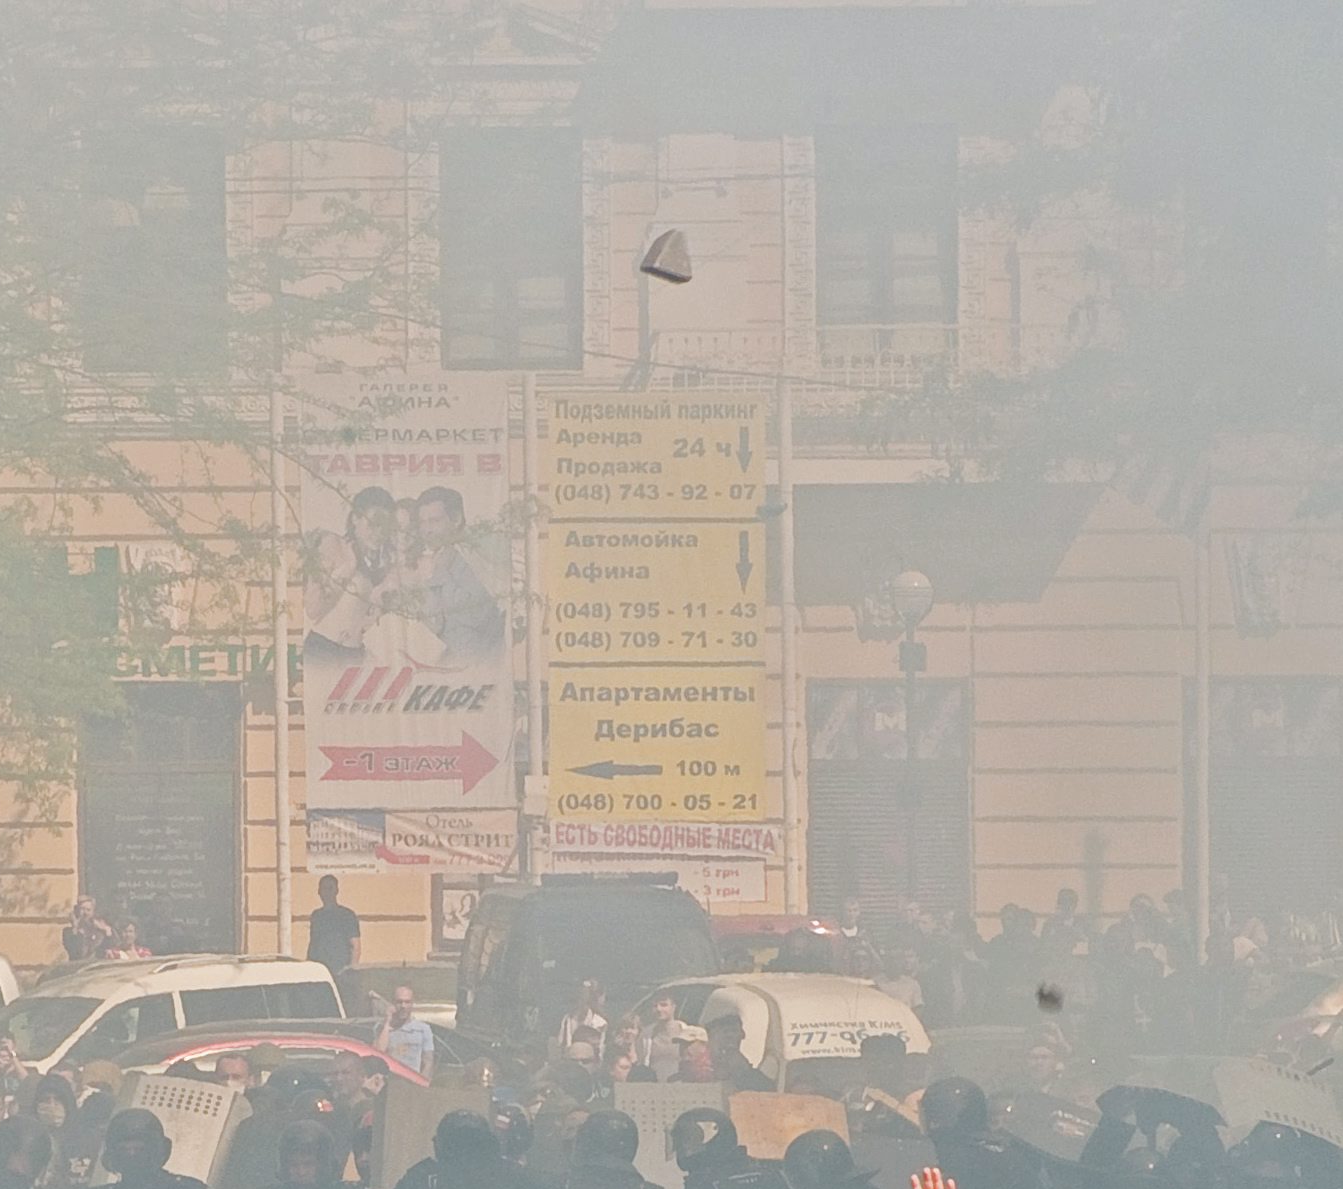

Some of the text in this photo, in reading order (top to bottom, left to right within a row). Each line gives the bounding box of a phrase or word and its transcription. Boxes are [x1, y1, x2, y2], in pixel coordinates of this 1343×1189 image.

[555, 401, 758, 422] Подземный паркинг
[556, 428, 643, 447] Аренда
[673, 437, 731, 457] 24 ч
[305, 453, 502, 475] ТАВРИЯ В
[556, 457, 662, 477] Продажа
[554, 483, 613, 505] (048)
[619, 484, 660, 501] 743
[681, 484, 708, 501] 92
[729, 484, 757, 501] 07
[565, 530, 698, 550] Автомойка
[565, 562, 650, 583] Афина
[555, 601, 613, 623] (048)
[619, 602, 660, 619] 795
[684, 602, 707, 619] 11
[730, 602, 757, 619] 43
[556, 630, 613, 652] (048)
[619, 631, 660, 649] 709
[683, 631, 707, 649] 71
[730, 631, 758, 649] 30
[402, 684, 494, 713] КАФЕ
[559, 683, 755, 706] Апартаменты
[595, 720, 720, 743] Дерибас
[343, 752, 458, 772] -1 ЭТАЖ
[676, 760, 742, 777] 100 м
[623, 794, 663, 811] 700
[684, 794, 712, 811] 05
[733, 794, 758, 811] 21
[425, 813, 474, 828] Отель
[447, 833, 514, 849] СТРИТ
[555, 823, 776, 851] ЕСТЬ СВОБОДНЫЕ МЕСТА
